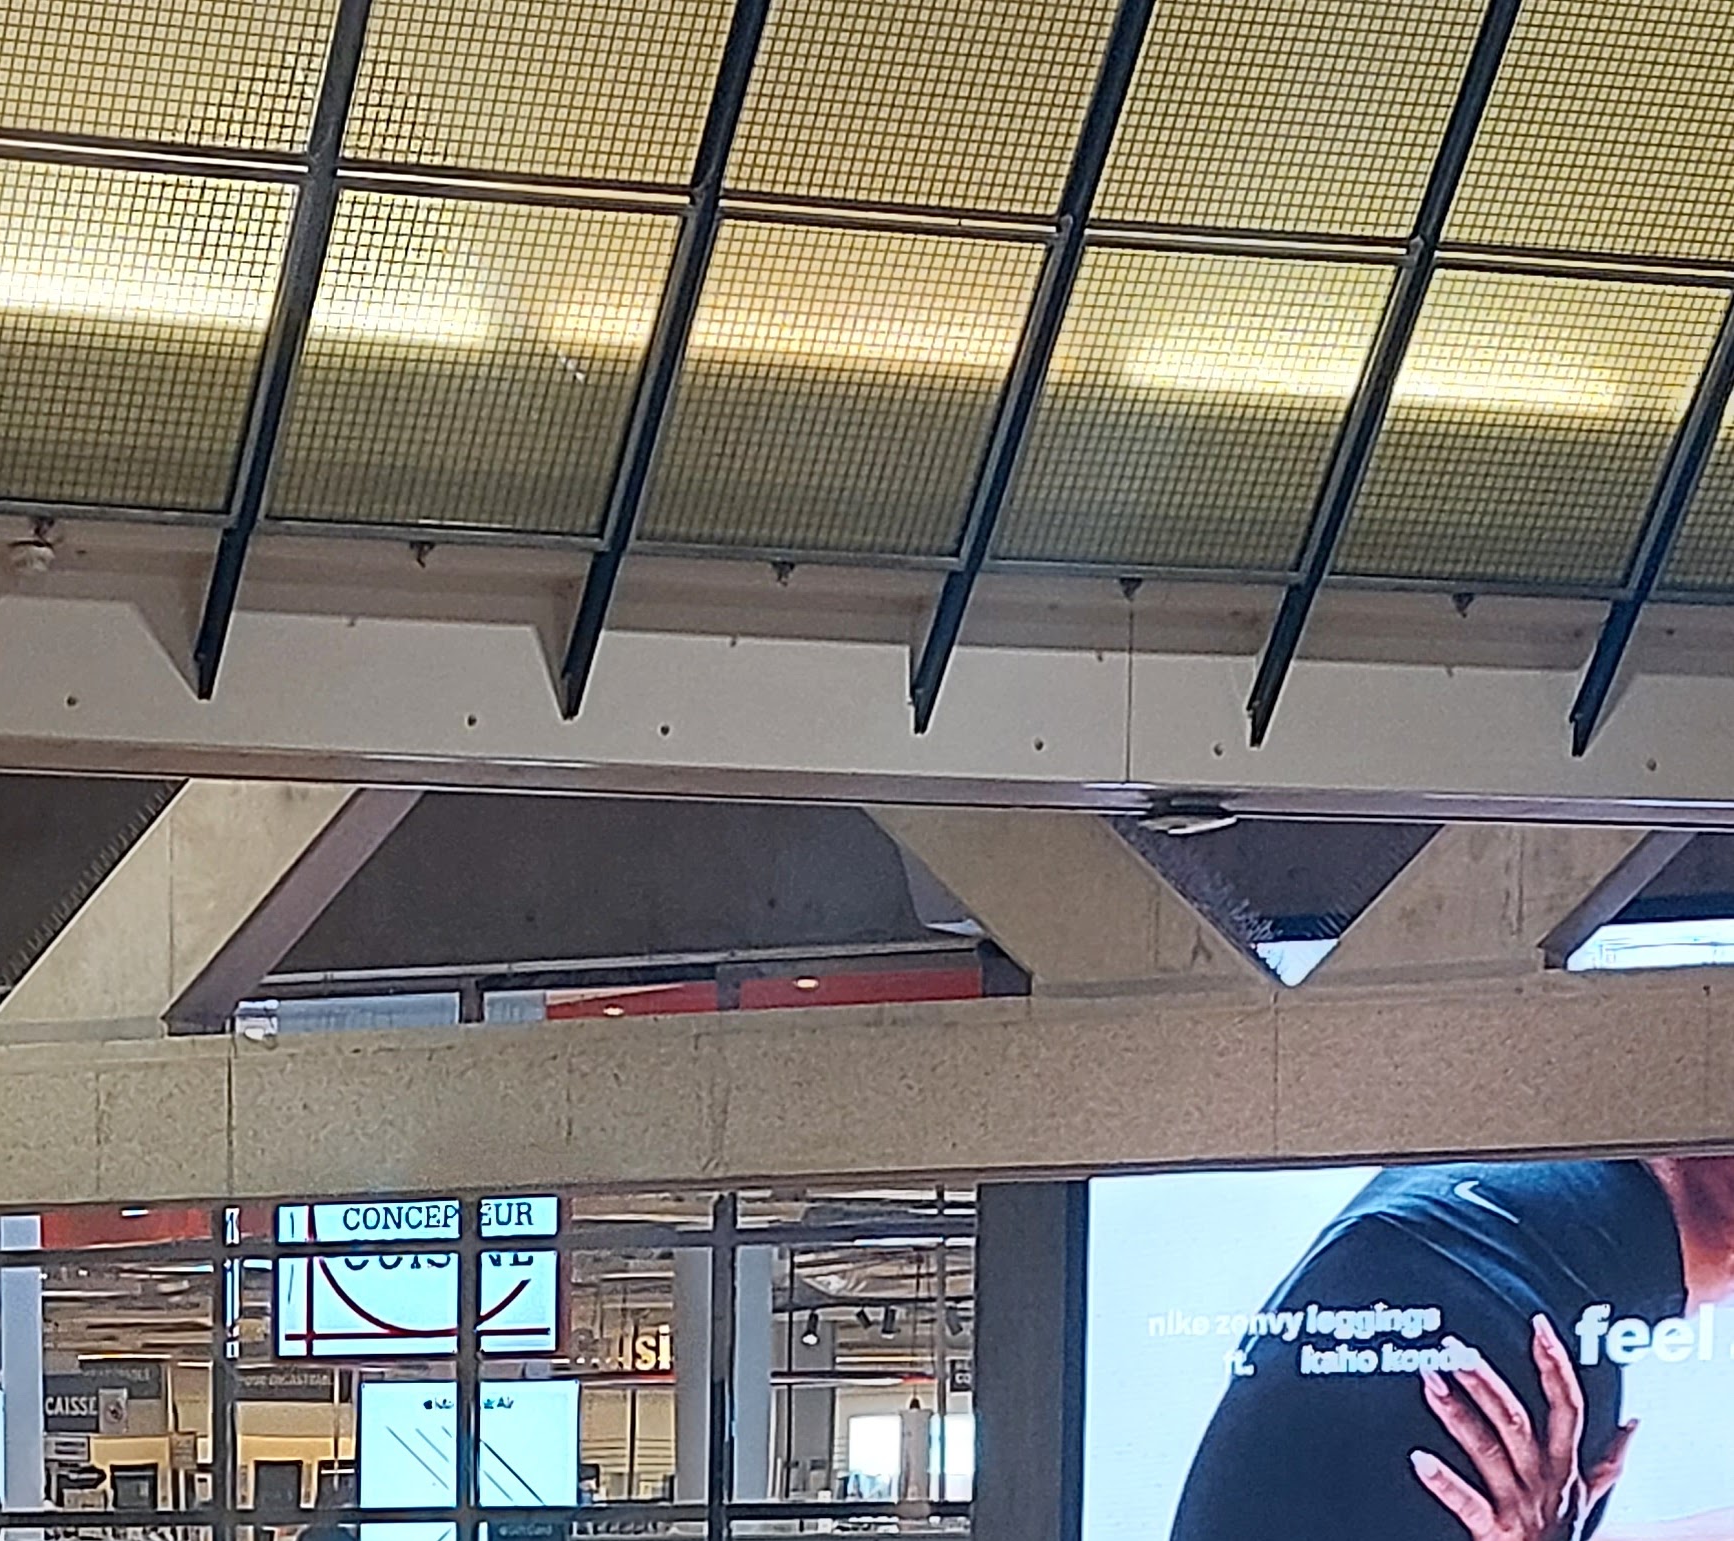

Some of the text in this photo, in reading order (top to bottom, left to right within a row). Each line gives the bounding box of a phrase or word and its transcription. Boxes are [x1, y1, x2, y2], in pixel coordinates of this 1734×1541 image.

[342, 1202, 534, 1230] CONCEPEUR
[1149, 1302, 1441, 1341] nike zenvy leggings
[1575, 1303, 1715, 1365] feel
[1301, 1344, 1378, 1374] kaho
[45, 1397, 98, 1415] CAISSE
